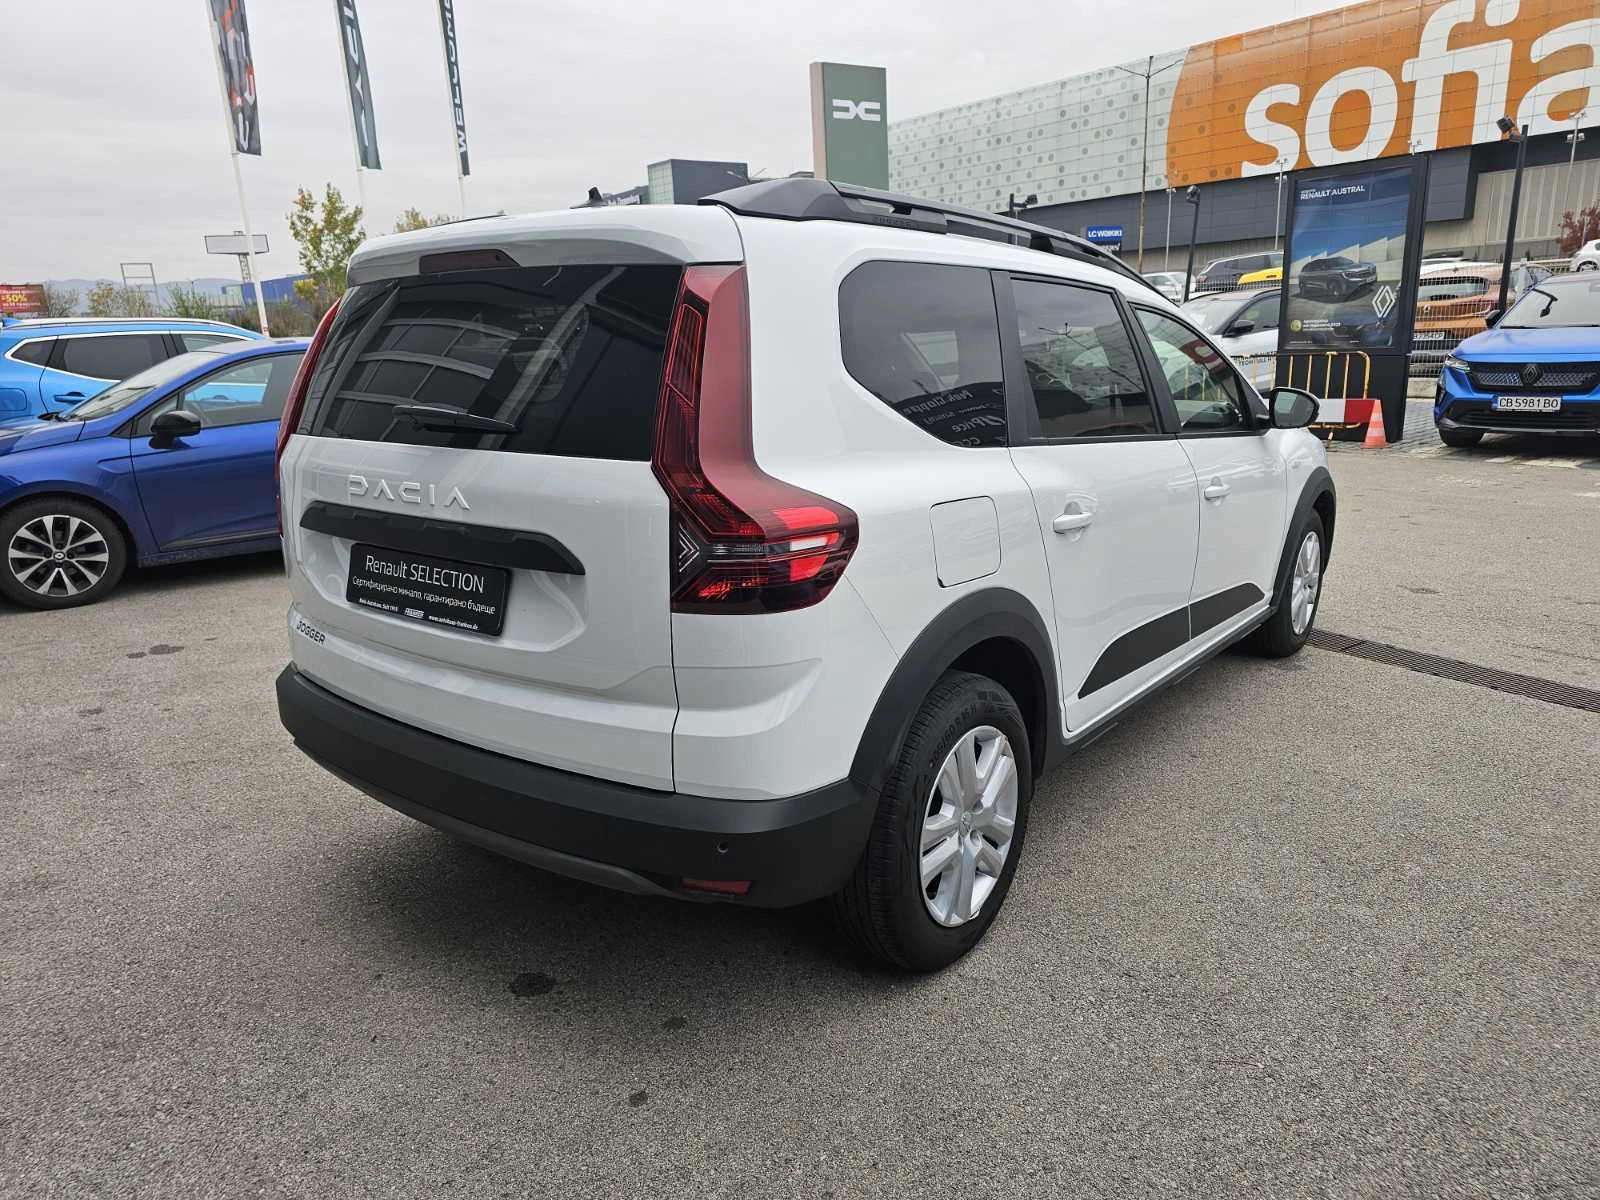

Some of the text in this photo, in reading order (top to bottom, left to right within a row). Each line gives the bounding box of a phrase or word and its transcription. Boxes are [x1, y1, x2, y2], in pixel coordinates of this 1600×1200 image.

[1241, 0, 1600, 178] sofia
[1300, 185, 1365, 201] RENAULT AUSTRAL
[348, 475, 471, 511] DACIA
[366, 555, 485, 593] Renault SELECTION
[352, 576, 398, 594] Сертифицирано
[423, 593, 467, 608] гарантирано
[467, 600, 496, 615] бъдеще
[296, 620, 326, 646] JOGGER
